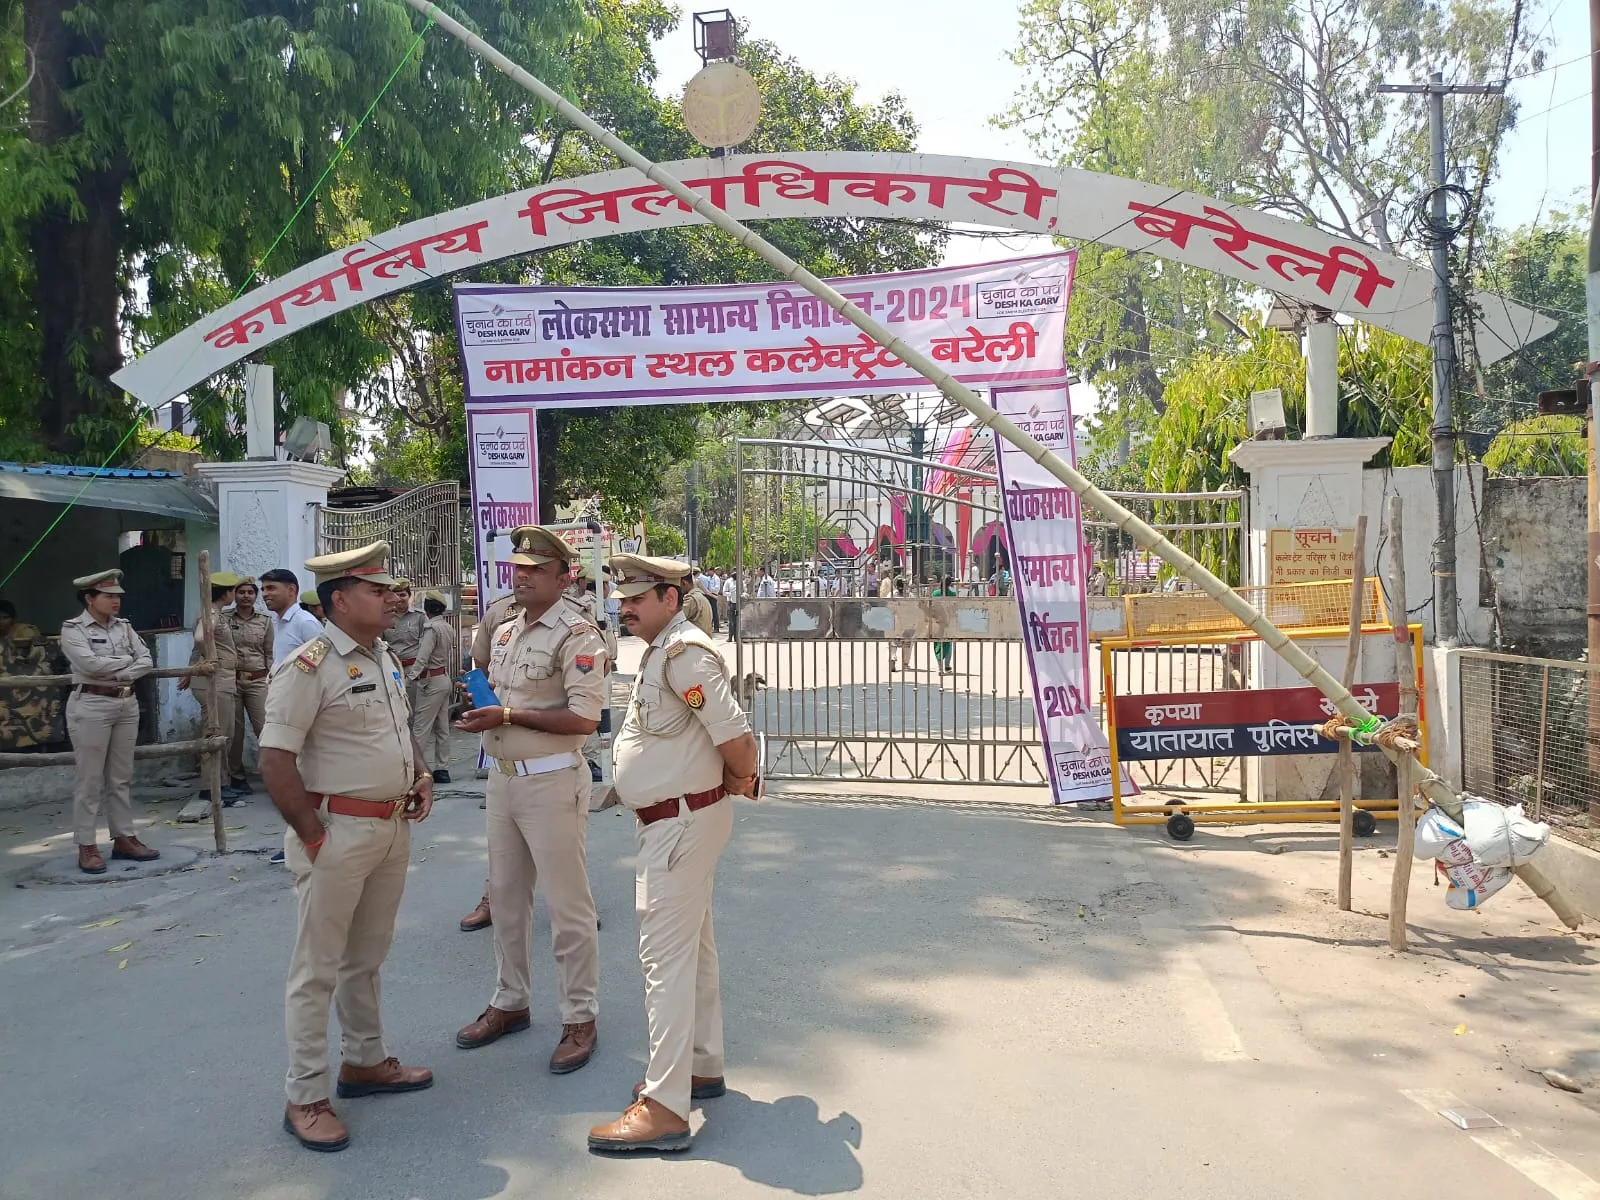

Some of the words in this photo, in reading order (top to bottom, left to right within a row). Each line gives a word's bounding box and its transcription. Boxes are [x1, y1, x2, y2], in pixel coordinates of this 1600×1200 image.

[1129, 201, 1394, 309] बरेली
[980, 288, 1016, 305] चुनाव
[1020, 286, 1039, 297] का
[995, 300, 1018, 309] DESH
[1020, 299, 1032, 307] KA
[1034, 296, 1059, 305] GARV
[466, 319, 494, 333] चुनाव
[496, 318, 513, 327] का
[538, 300, 652, 341] लोकसभा
[660, 299, 758, 335] सामान्य
[477, 329, 496, 337] DESH
[509, 328, 530, 336] GARV
[483, 348, 636, 383] नामांकन
[646, 350, 737, 379] स्थल
[929, 321, 1039, 363] बरेली
[1033, 421, 1048, 431] का
[1034, 433, 1044, 442] KA
[1045, 433, 1064, 441] GARV
[479, 492, 533, 529] लोकसभा
[1145, 703, 1202, 725] कृपया
[1129, 728, 1234, 752] यातायात
[1247, 719, 1318, 752] पुलिस
[1073, 772, 1090, 780] DESH
